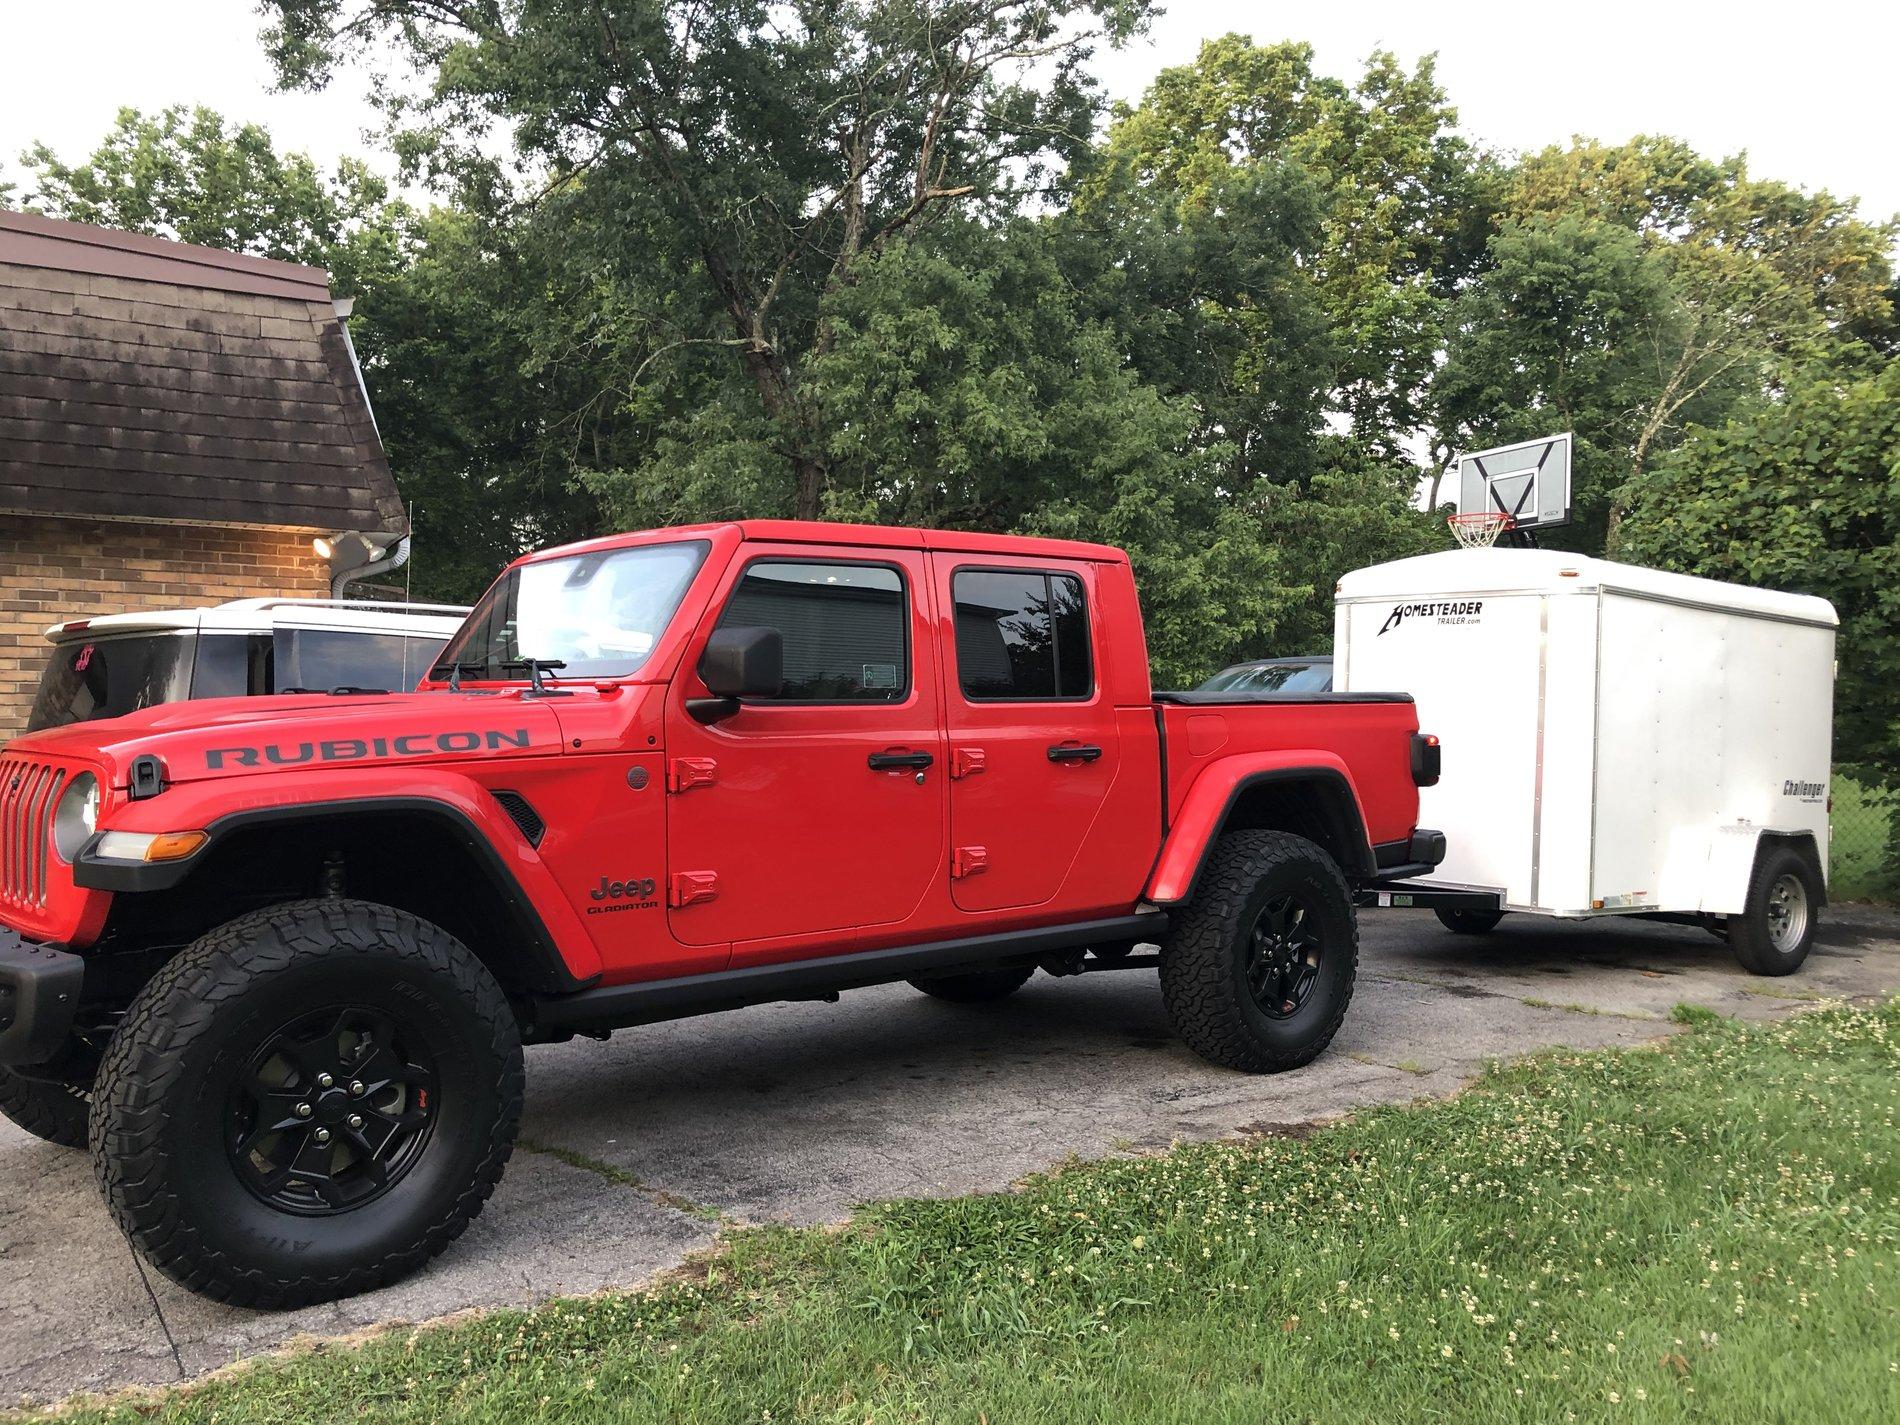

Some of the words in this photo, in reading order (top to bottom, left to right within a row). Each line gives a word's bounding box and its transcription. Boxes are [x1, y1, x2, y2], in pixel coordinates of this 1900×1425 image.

[1377, 602, 1483, 637] HOMESTEADER
[205, 728, 530, 770] RUBICON
[1783, 780, 1825, 798] Challenger
[591, 875, 656, 901] Jeep
[587, 901, 658, 915] GLADIATOR
